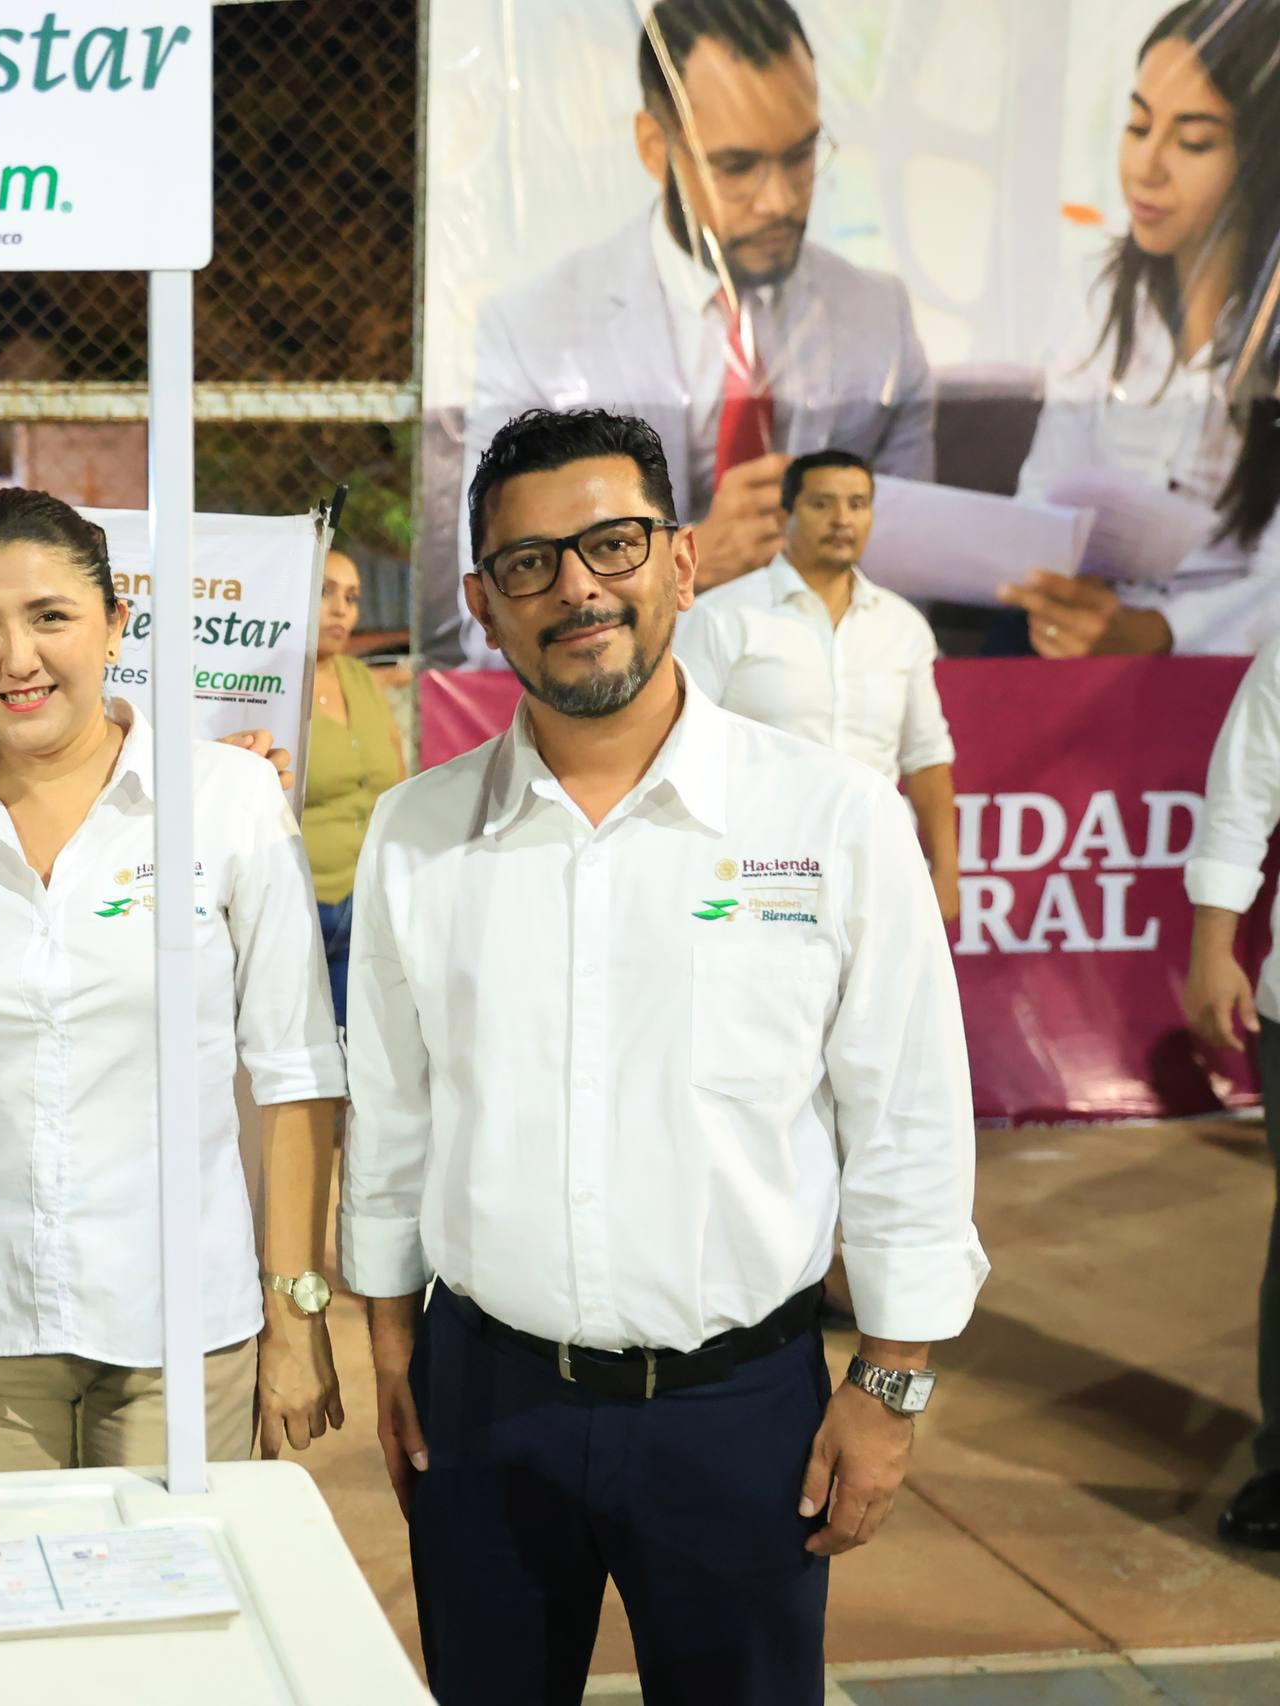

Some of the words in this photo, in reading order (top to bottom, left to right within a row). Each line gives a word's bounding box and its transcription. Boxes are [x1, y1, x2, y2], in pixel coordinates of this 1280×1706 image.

[954, 789, 1204, 872] IDAD
[742, 857, 820, 872] Hacienda
[761, 909, 817, 922] Bienestar
[954, 872, 1161, 955] RAL
